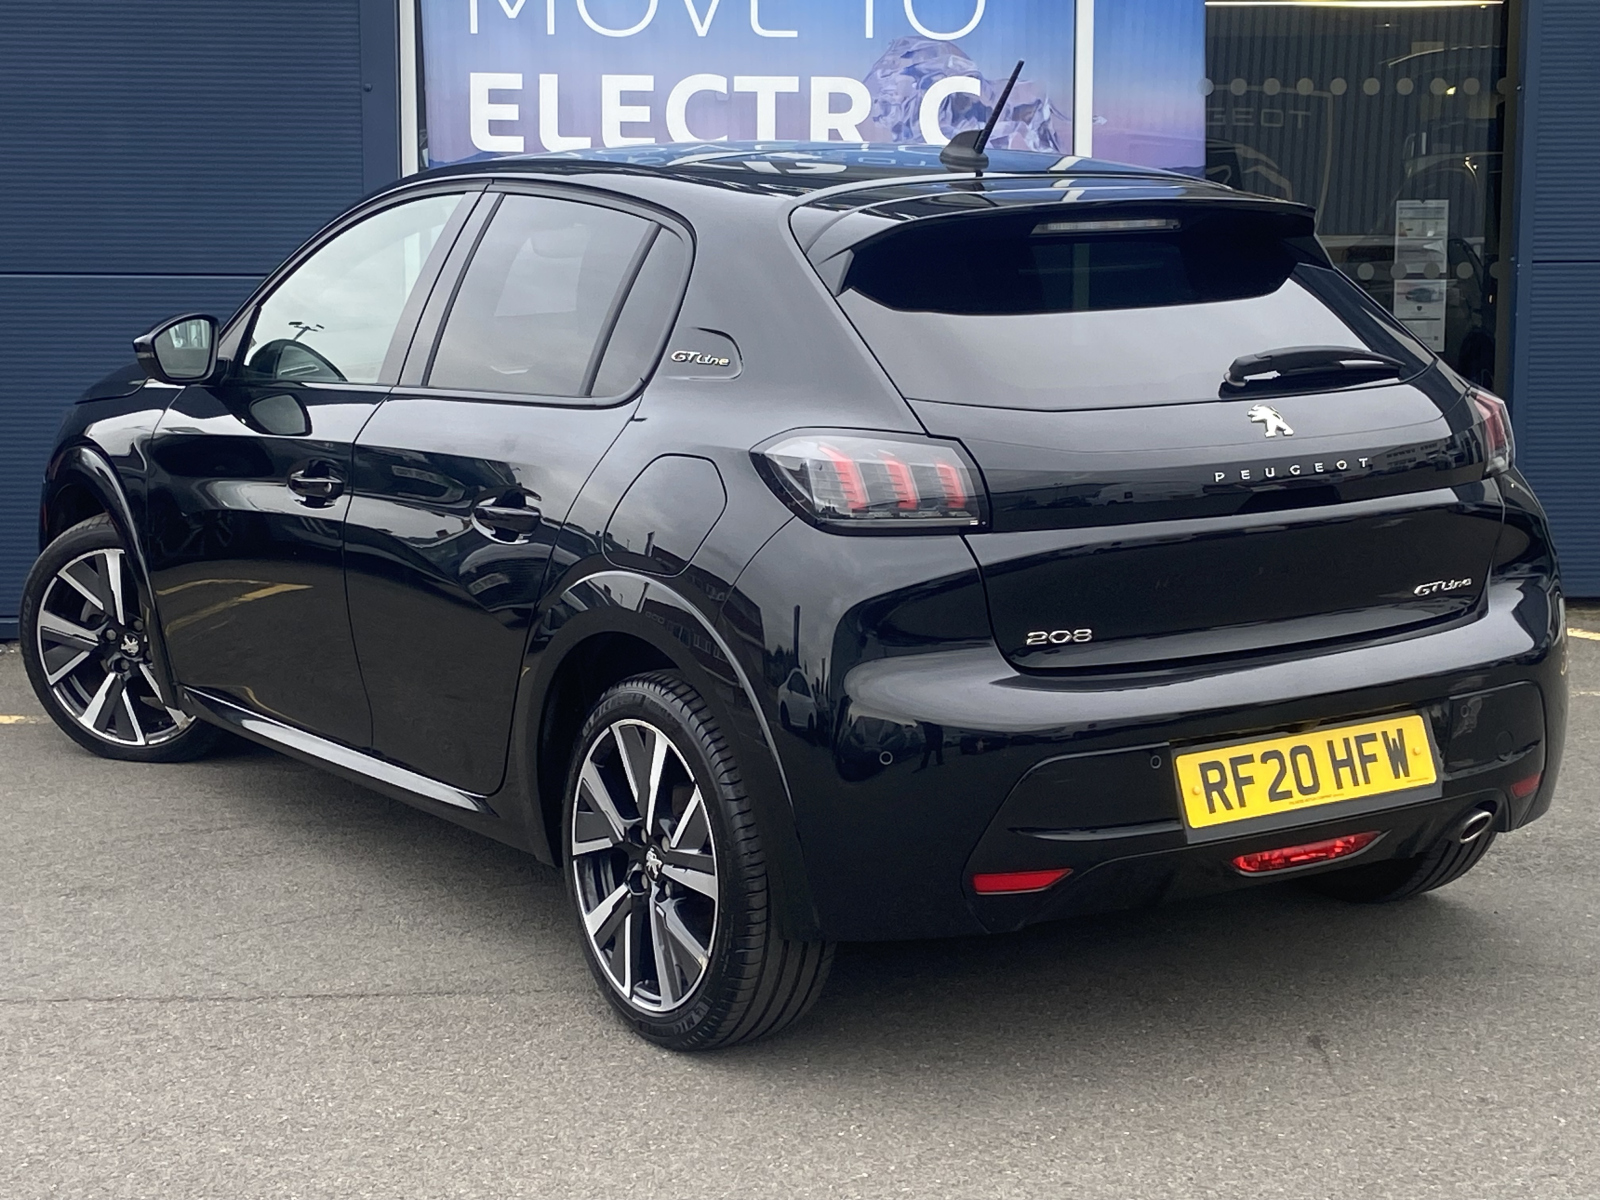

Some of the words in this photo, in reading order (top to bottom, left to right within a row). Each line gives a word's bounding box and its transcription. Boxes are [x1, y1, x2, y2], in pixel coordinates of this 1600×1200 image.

[1214, 457, 1368, 483] PEUGEOT
[1026, 628, 1093, 645] 208
[1198, 744, 1321, 815] RF20
[1326, 728, 1411, 791] HFW
